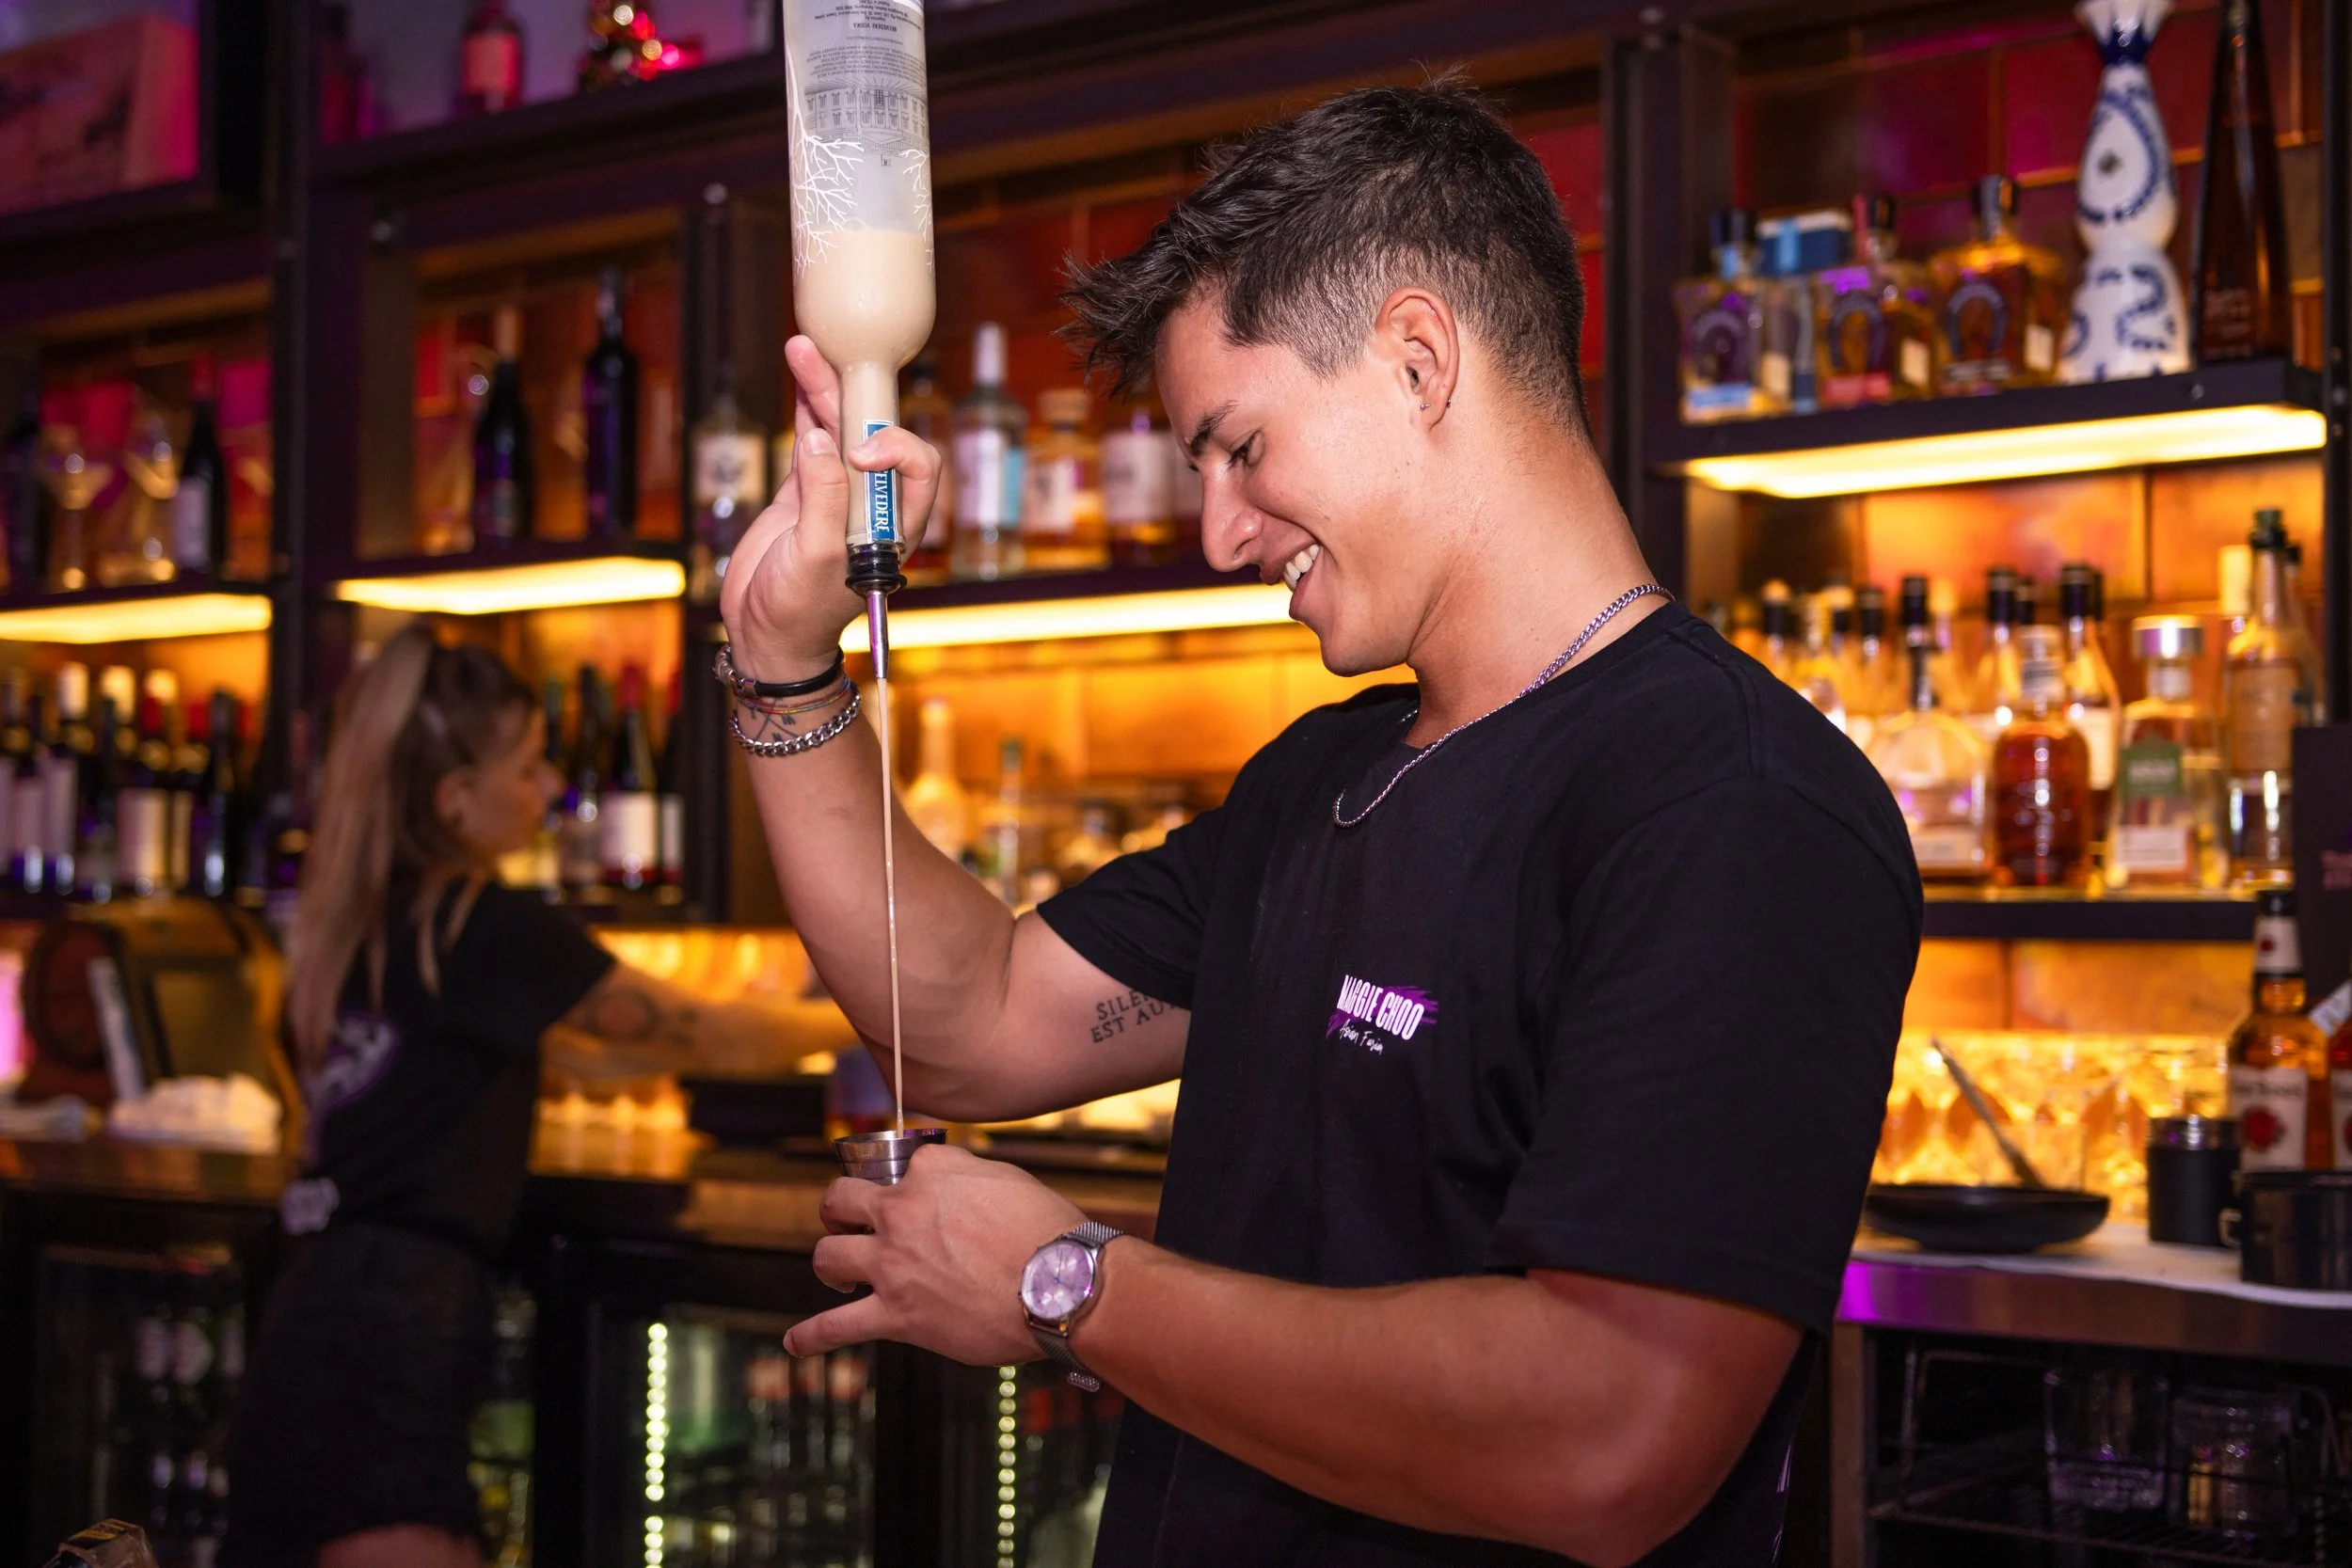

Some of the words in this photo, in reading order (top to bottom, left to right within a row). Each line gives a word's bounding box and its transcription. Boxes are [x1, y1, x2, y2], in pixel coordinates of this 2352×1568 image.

[874, 470, 889, 532] ELVEDERE
[1089, 1016, 1125, 1043] EST
[1136, 1000, 1176, 1025] AU
[1336, 974, 1384, 1022] MAGGIE
[1375, 990, 1425, 1041] CHOO
